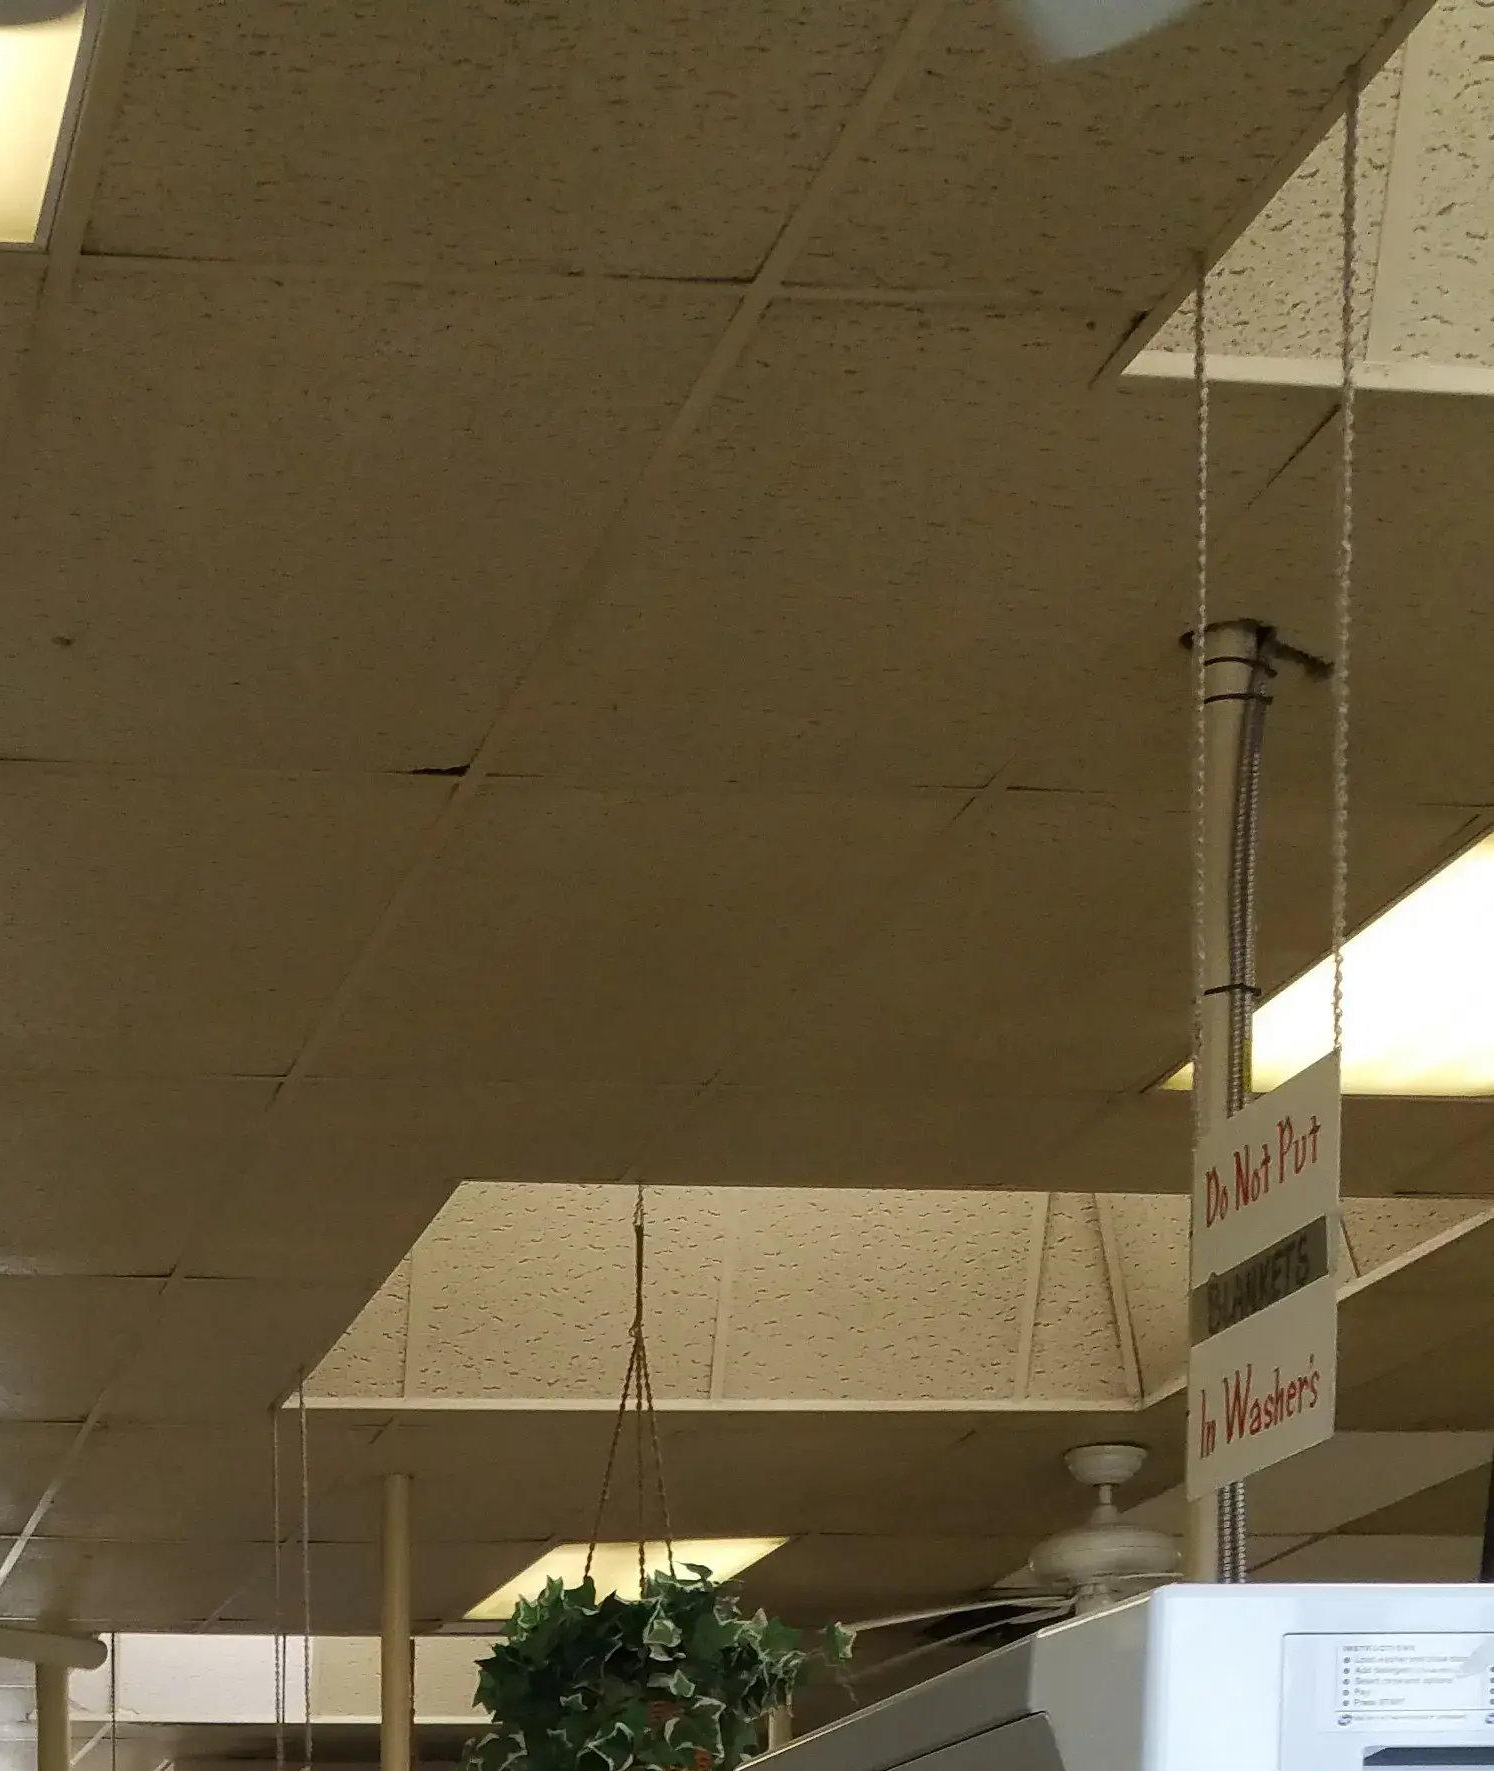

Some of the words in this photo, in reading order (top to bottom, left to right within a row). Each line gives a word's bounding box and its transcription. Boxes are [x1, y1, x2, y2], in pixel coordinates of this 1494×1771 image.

[1205, 1166, 1229, 1229] Do
[1233, 1143, 1272, 1211] Not
[1277, 1115, 1322, 1184] Put
[1207, 1235, 1310, 1335] BLANKETS
[1200, 1389, 1217, 1459] In
[1222, 1353, 1321, 1444] Washer's
